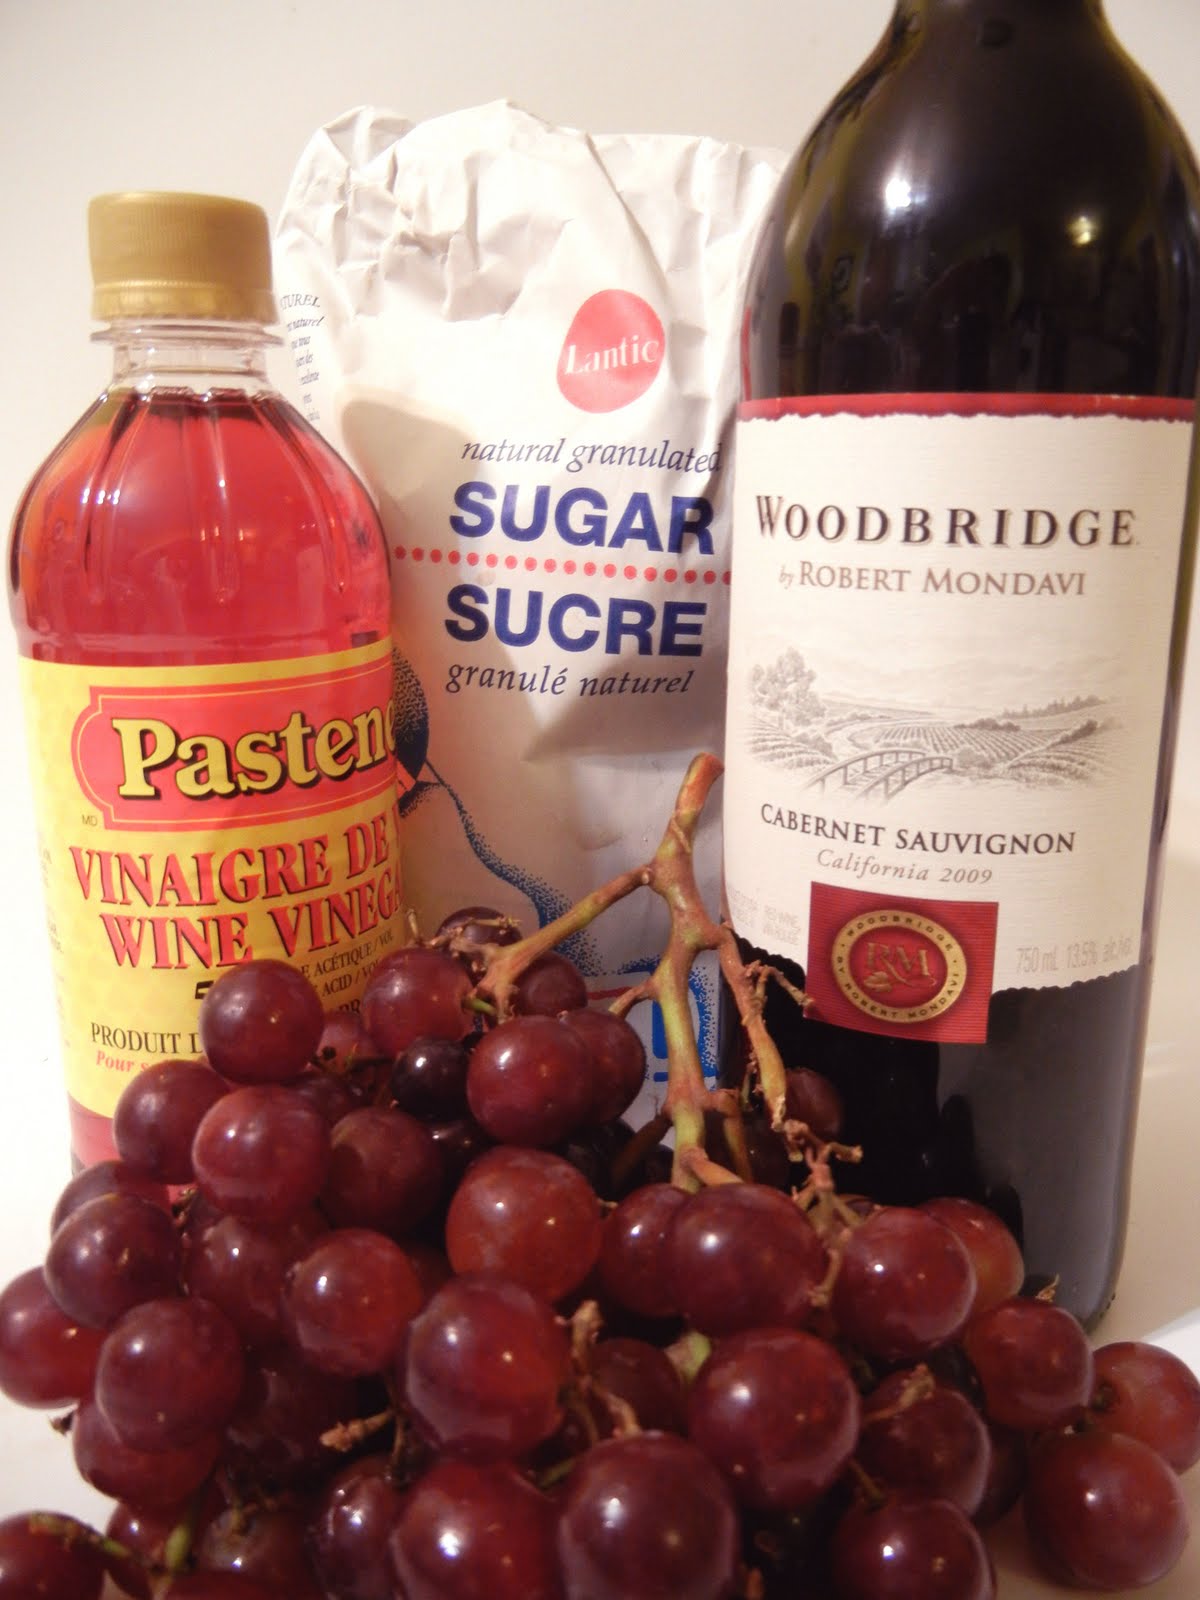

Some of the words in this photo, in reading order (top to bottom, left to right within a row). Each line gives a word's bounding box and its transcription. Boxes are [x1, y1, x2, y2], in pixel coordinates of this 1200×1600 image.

[564, 336, 660, 376] Lantic
[460, 438, 567, 464] natural
[566, 440, 723, 473] granulated
[449, 480, 716, 555] SUGAR
[755, 494, 1138, 549] WOODBRIDGE
[778, 563, 795, 590] by
[798, 559, 912, 594] ROBERT
[921, 566, 1087, 597] MONDAVI
[444, 583, 708, 657] SUCRE
[445, 663, 567, 695] granulé
[579, 670, 696, 698] naturel
[760, 802, 886, 848] CABERNET
[895, 828, 1077, 856] SAUVIGNON
[69, 833, 334, 908] VINAIGRE
[343, 810, 390, 880] DE
[816, 848, 930, 882] California
[938, 866, 994, 885] 2009
[99, 910, 255, 972] WINE
[847, 914, 954, 952] WOODBRIDGE
[907, 972, 960, 1019] MONDAVI
[90, 1021, 181, 1055] PRODUIT
[95, 1049, 135, 1073] Pour
